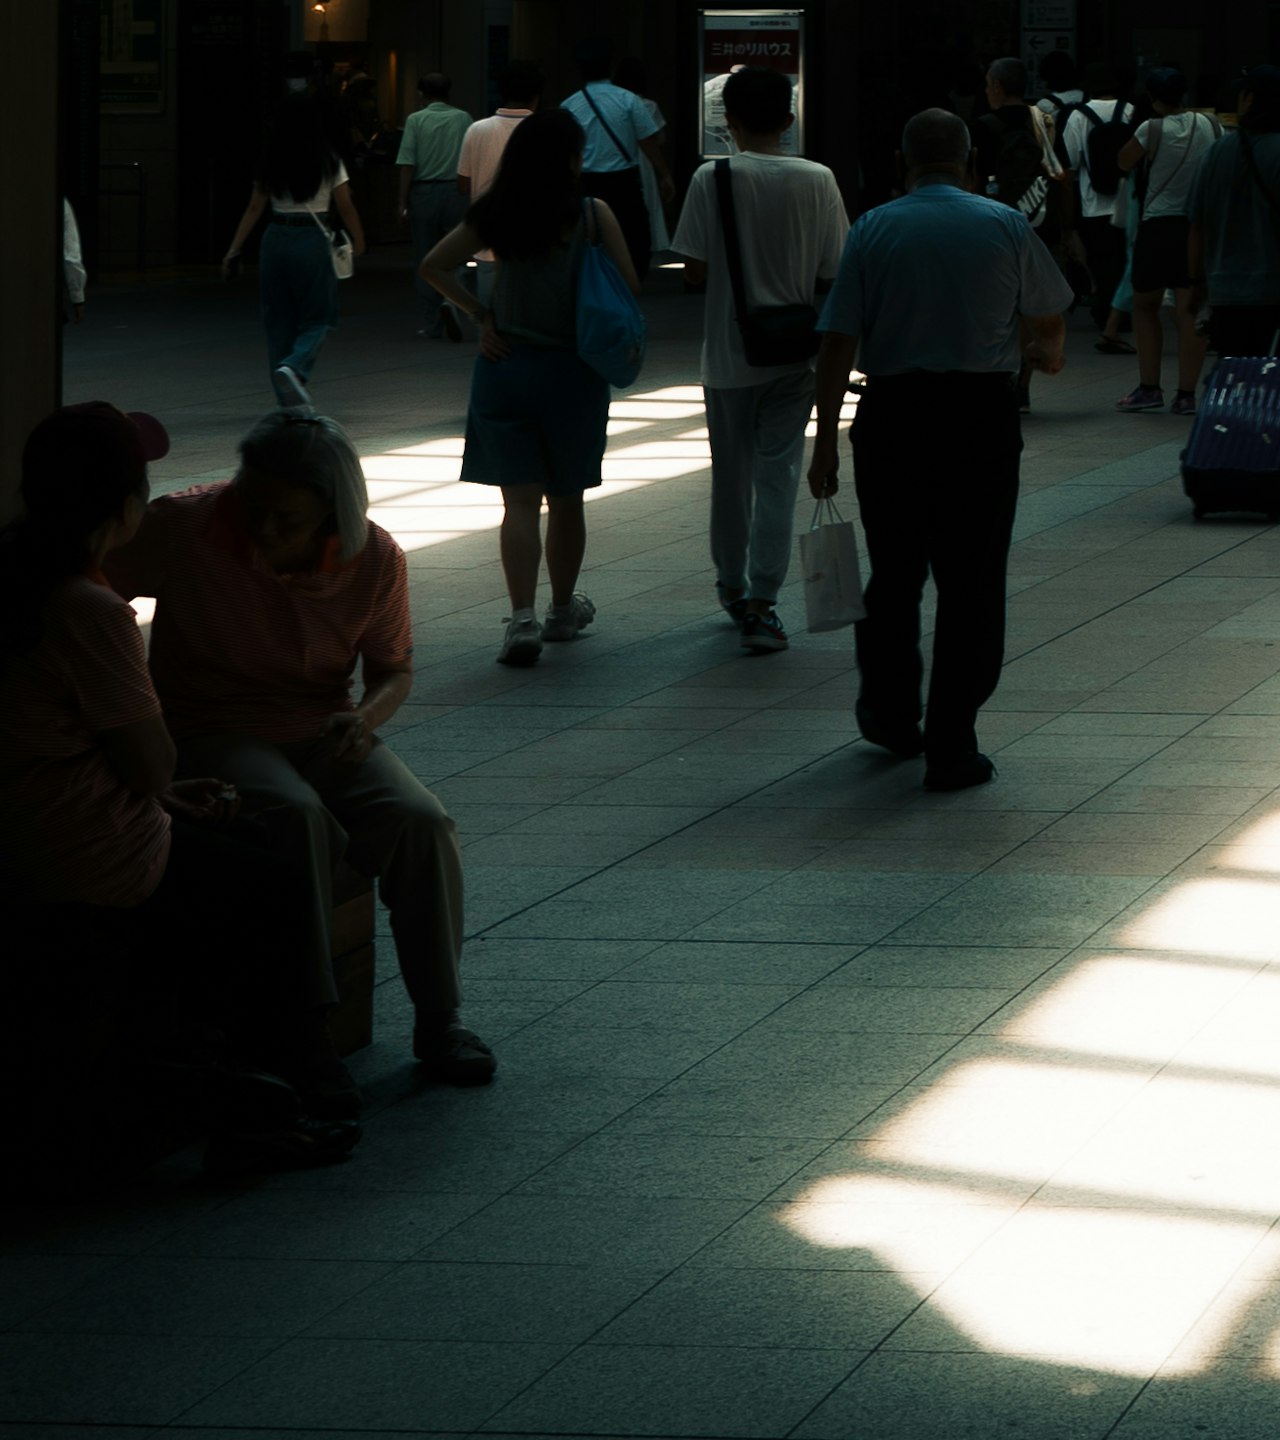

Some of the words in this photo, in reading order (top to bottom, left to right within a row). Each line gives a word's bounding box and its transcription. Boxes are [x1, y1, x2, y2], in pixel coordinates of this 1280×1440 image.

[711, 42, 793, 57] 三井のリハウス
